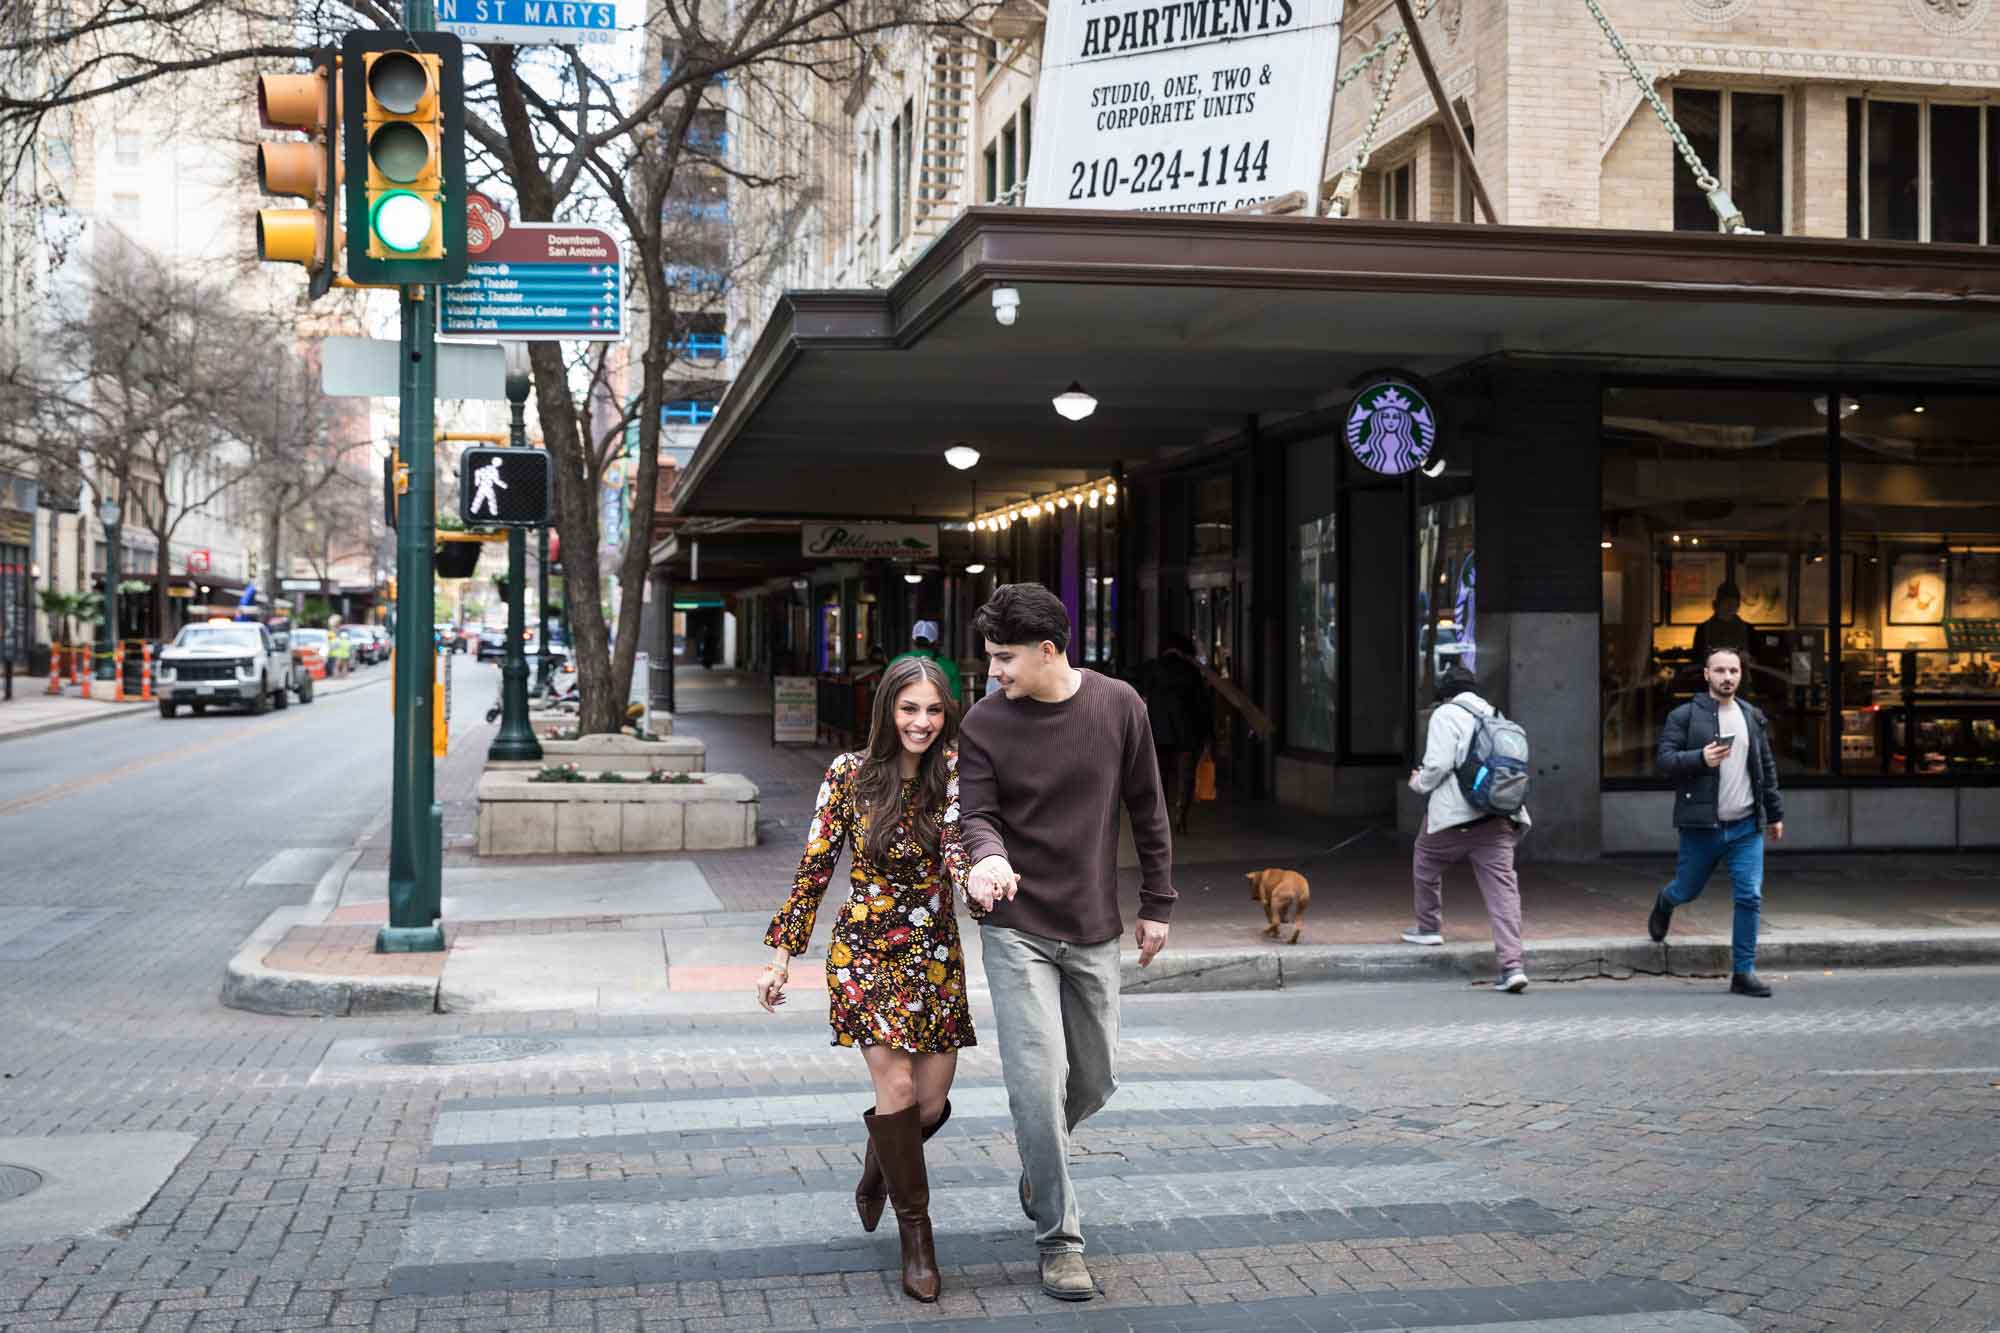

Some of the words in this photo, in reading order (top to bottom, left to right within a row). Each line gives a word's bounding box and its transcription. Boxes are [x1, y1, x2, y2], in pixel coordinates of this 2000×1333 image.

[444, 0, 456, 20] N
[476, 1, 507, 21] ST
[524, 4, 611, 28] MARYS
[1081, 0, 1293, 58] APARTMENTS
[1091, 81, 1155, 108] STUDIO,
[1164, 74, 1202, 99] ONE,
[1213, 66, 1252, 92] TWO
[1259, 63, 1272, 86] &
[1097, 99, 1196, 132] CORPORATE
[1203, 92, 1256, 119] UNITS
[1069, 140, 1270, 200] 210-224-1144
[548, 235, 600, 245] Downtown
[548, 246, 567, 257] San
[568, 247, 608, 257] Antonio
[467, 265, 498, 276] Alamo
[483, 277, 519, 289] Theater
[448, 291, 485, 303] Majestic
[488, 291, 524, 302] Theater
[448, 306, 477, 316] Visitor
[479, 305, 535, 317] Information
[535, 305, 568, 317] Center
[448, 318, 474, 329] Travis
[476, 318, 498, 329] Park
